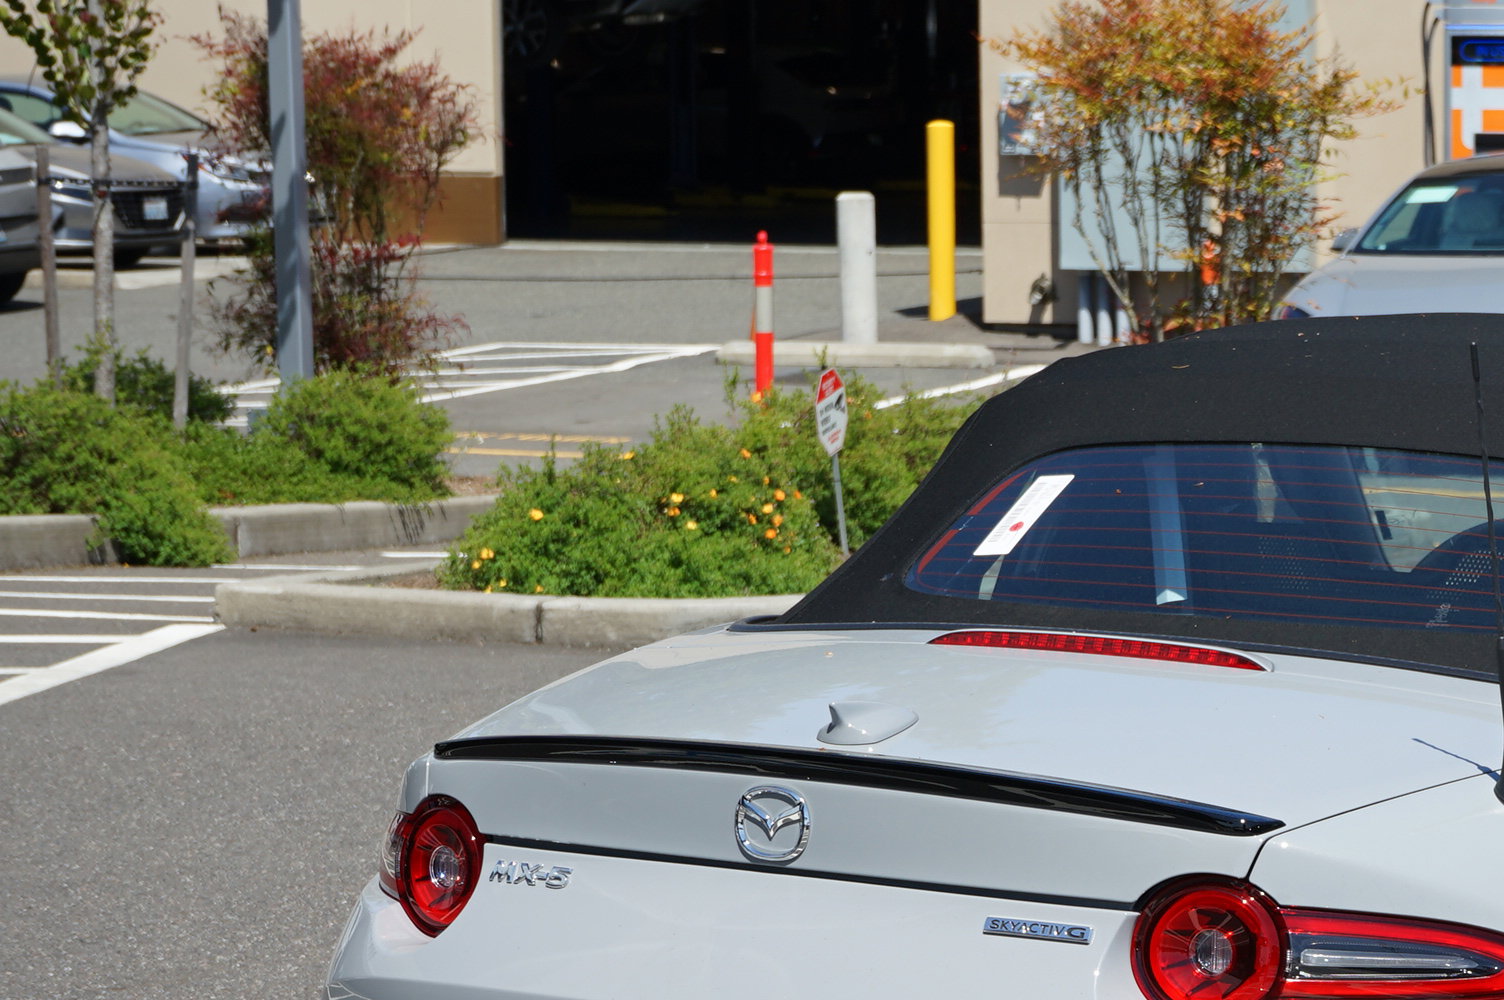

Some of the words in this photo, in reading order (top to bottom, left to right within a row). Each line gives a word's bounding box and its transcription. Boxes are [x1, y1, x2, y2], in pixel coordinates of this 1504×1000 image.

[1475, 45, 1487, 57] IN
[489, 859, 574, 890] MX-5
[989, 918, 1065, 937] SKYACTIV
